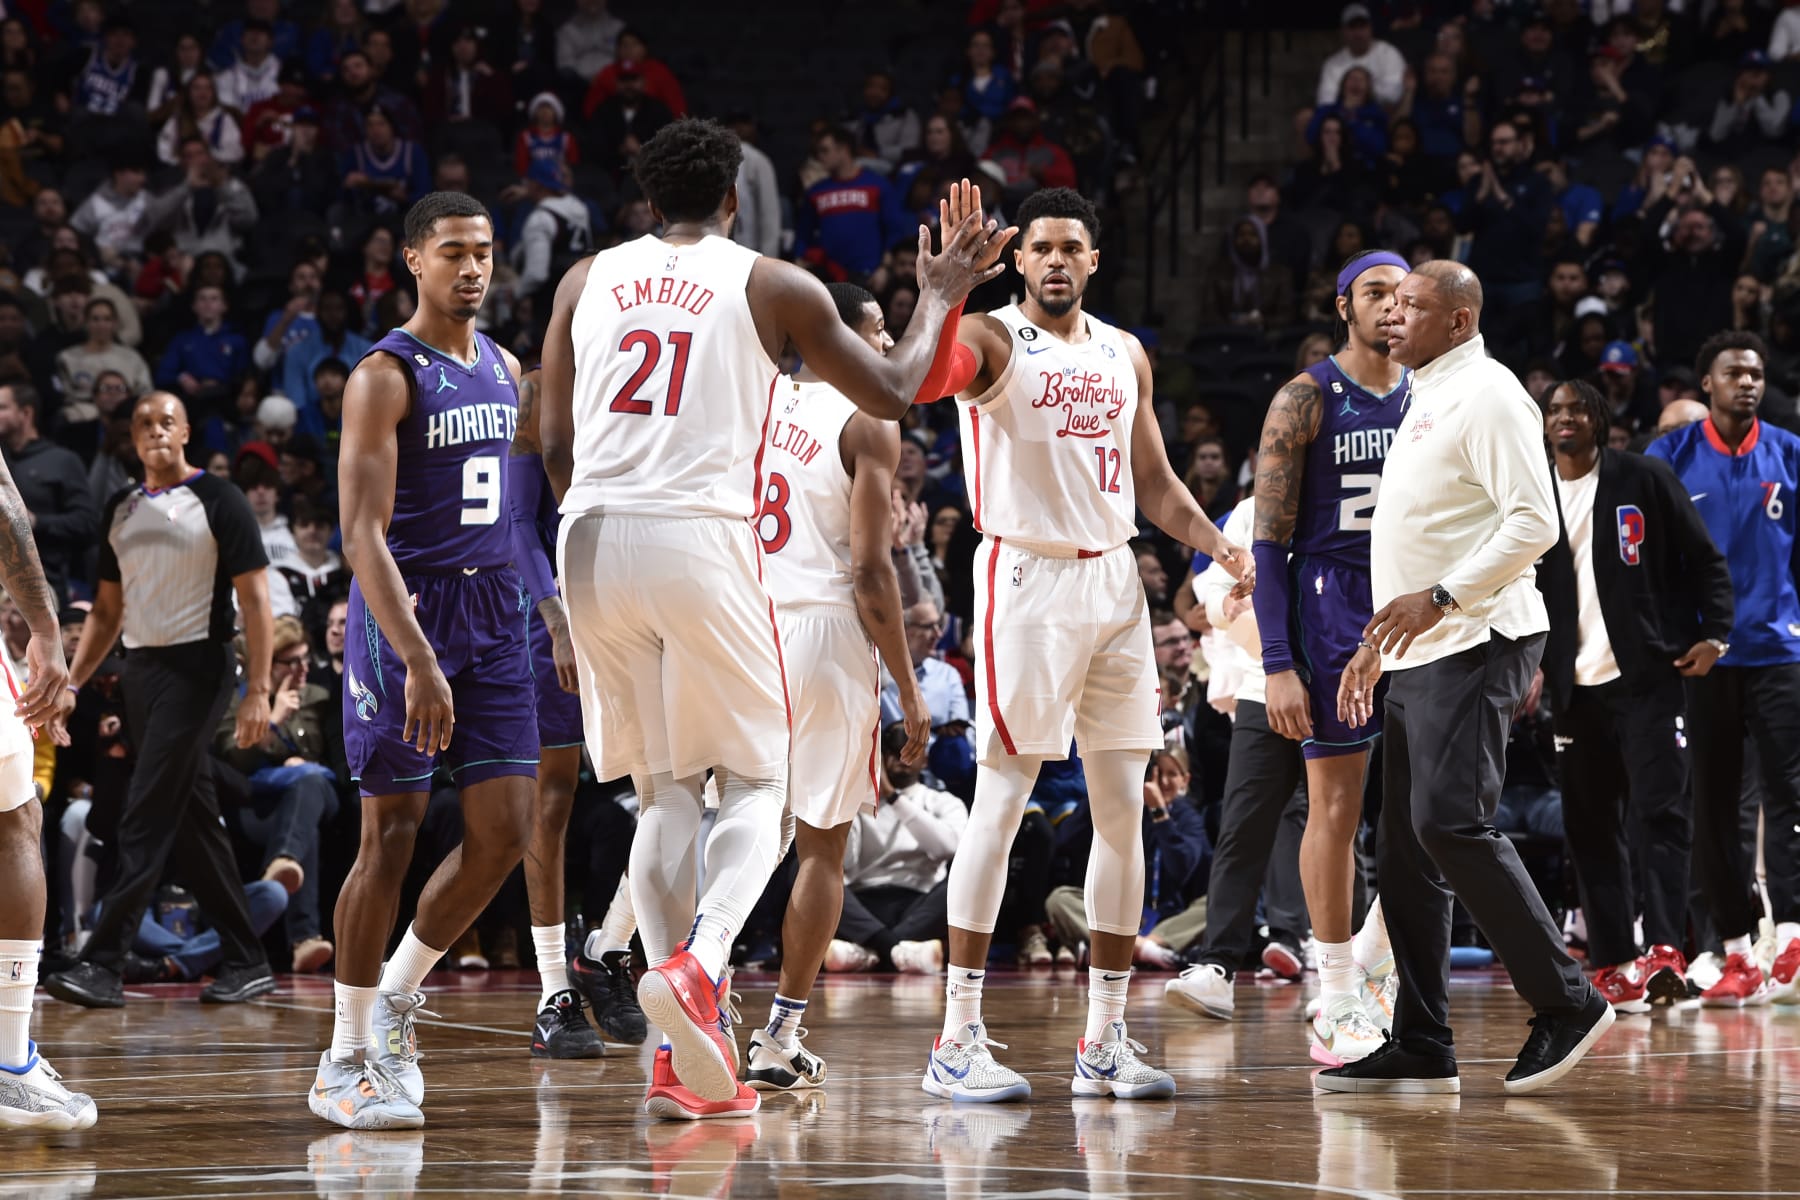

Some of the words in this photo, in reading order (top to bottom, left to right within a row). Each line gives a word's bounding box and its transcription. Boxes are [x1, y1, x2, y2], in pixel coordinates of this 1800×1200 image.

[611, 277, 714, 315] EMBIID
[1022, 329, 1033, 340] 6
[414, 353, 429, 367] 6
[609, 329, 693, 416] 21
[1032, 371, 1127, 420] Brotherly
[424, 403, 518, 449] HORNETS
[1056, 403, 1111, 439] Love
[460, 456, 501, 525] 9
[1094, 446, 1121, 494] 12
[754, 471, 792, 555] 8
[1339, 473, 1382, 531] 2
[1760, 481, 1783, 520] 76
